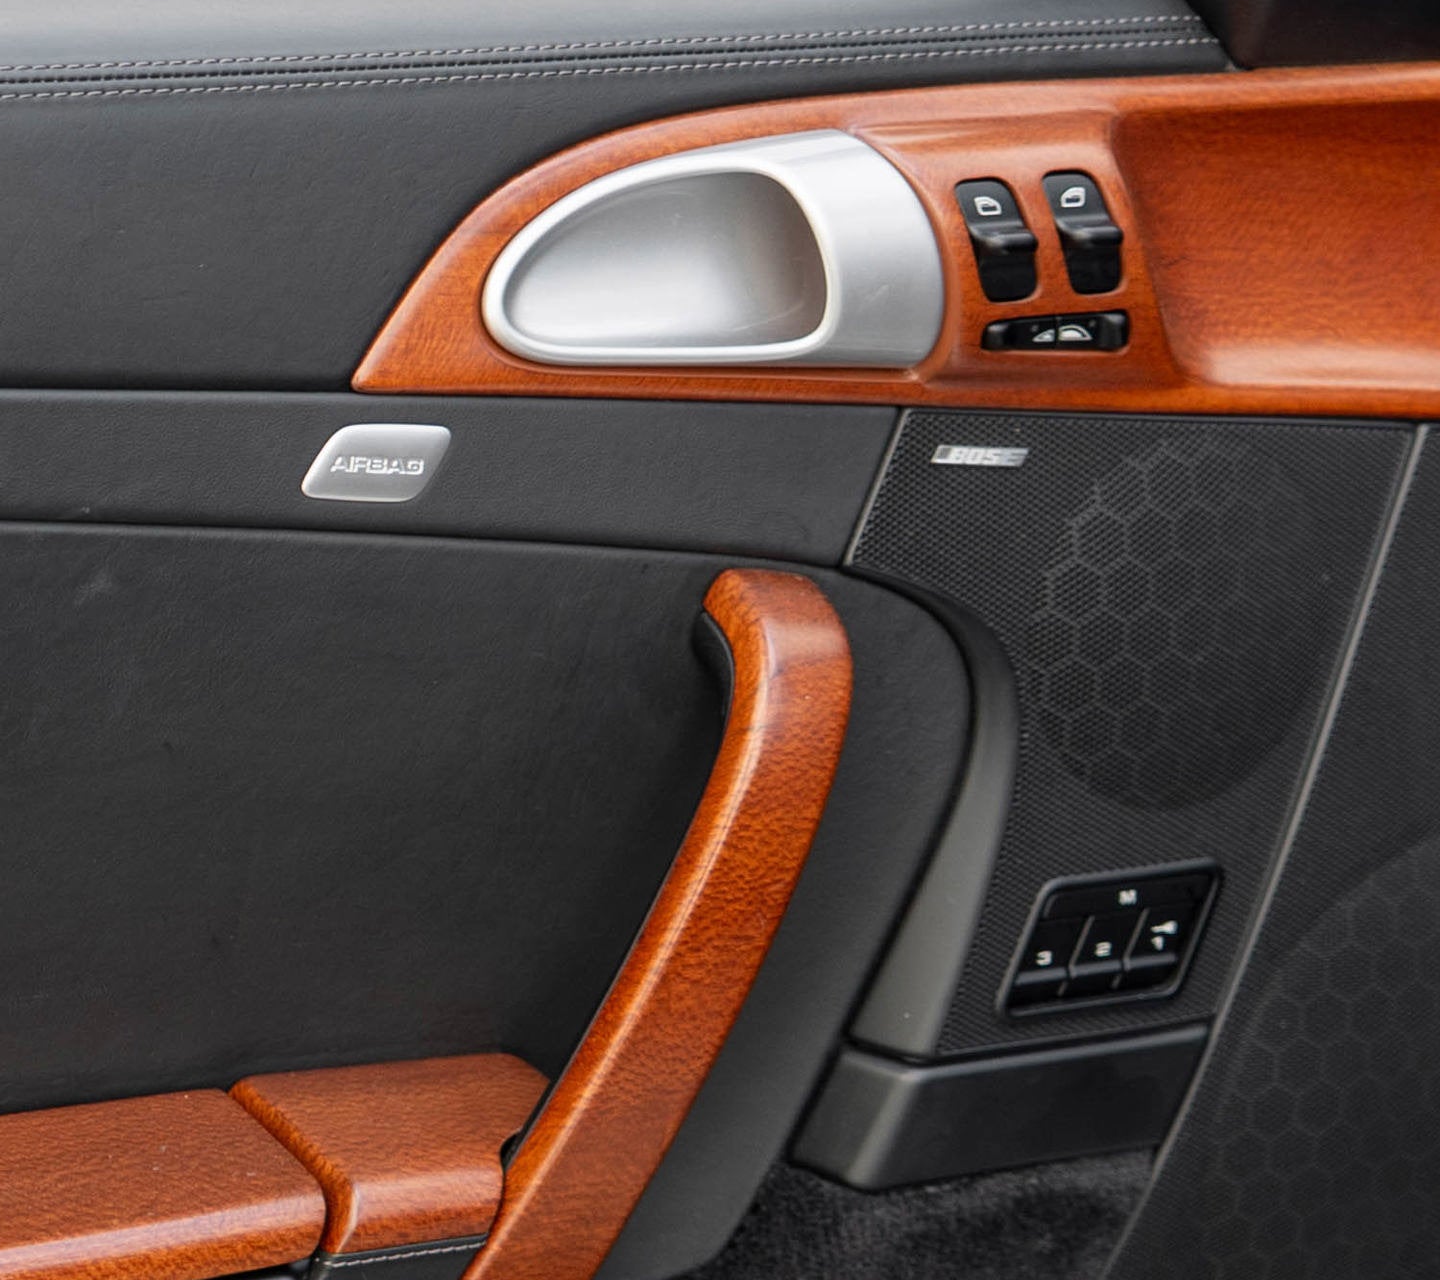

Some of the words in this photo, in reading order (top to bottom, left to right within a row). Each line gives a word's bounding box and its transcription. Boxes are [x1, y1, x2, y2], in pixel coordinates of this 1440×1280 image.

[329, 455, 425, 475] AIRBAG
[946, 446, 1029, 466] BOSE
[1118, 889, 1138, 906] M
[1035, 949, 1054, 966] 3
[1094, 940, 1112, 957] 2
